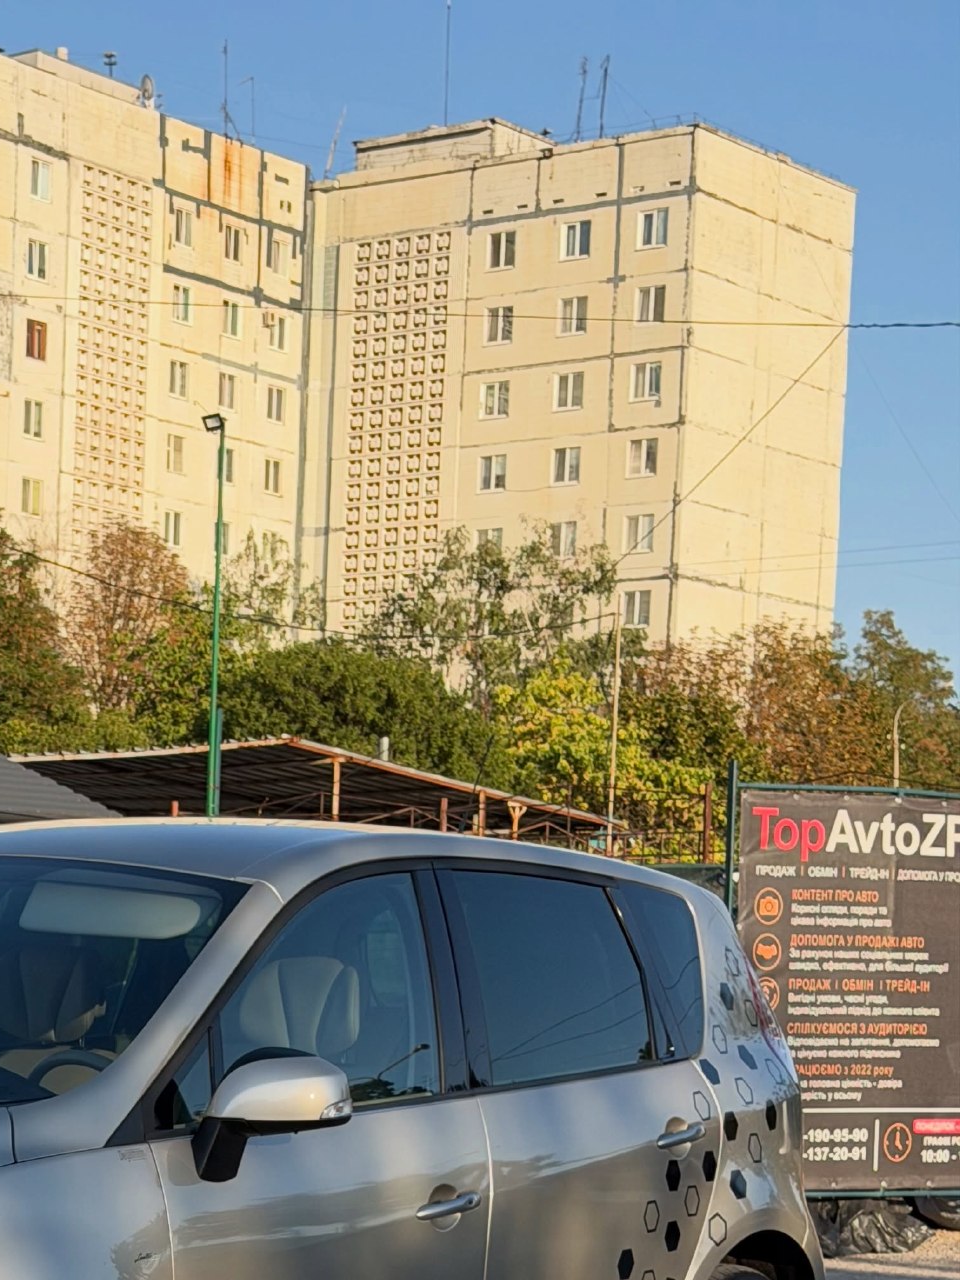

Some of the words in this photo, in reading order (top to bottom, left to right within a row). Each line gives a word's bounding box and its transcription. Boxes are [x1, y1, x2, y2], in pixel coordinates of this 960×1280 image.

[755, 865, 796, 878] ПРОДАЖ
[808, 866, 838, 878] ОБМІН
[792, 889, 833, 901] КОНТЕНТ
[835, 890, 854, 902] ПРО
[855, 891, 879, 903] АВТО
[790, 934, 845, 948] ДОПОМОГА
[846, 935, 854, 947] У
[855, 935, 899, 948] ПРОДАЖІ
[900, 936, 925, 948] АВТО
[789, 978, 831, 991] ПРОДАЖ
[842, 979, 874, 991] ОБМІН
[886, 978, 930, 993] ТРЕЙД-ІН
[787, 1023, 858, 1035] СПІЛКУЄМОСЯ
[867, 1023, 928, 1036] АУДИТОРІЄЮ
[795, 1064, 842, 1077] АЦЮЄМО
[850, 1065, 872, 1076] 2022
[873, 1066, 894, 1077] року
[920, 1149, 950, 1163] 10:00
